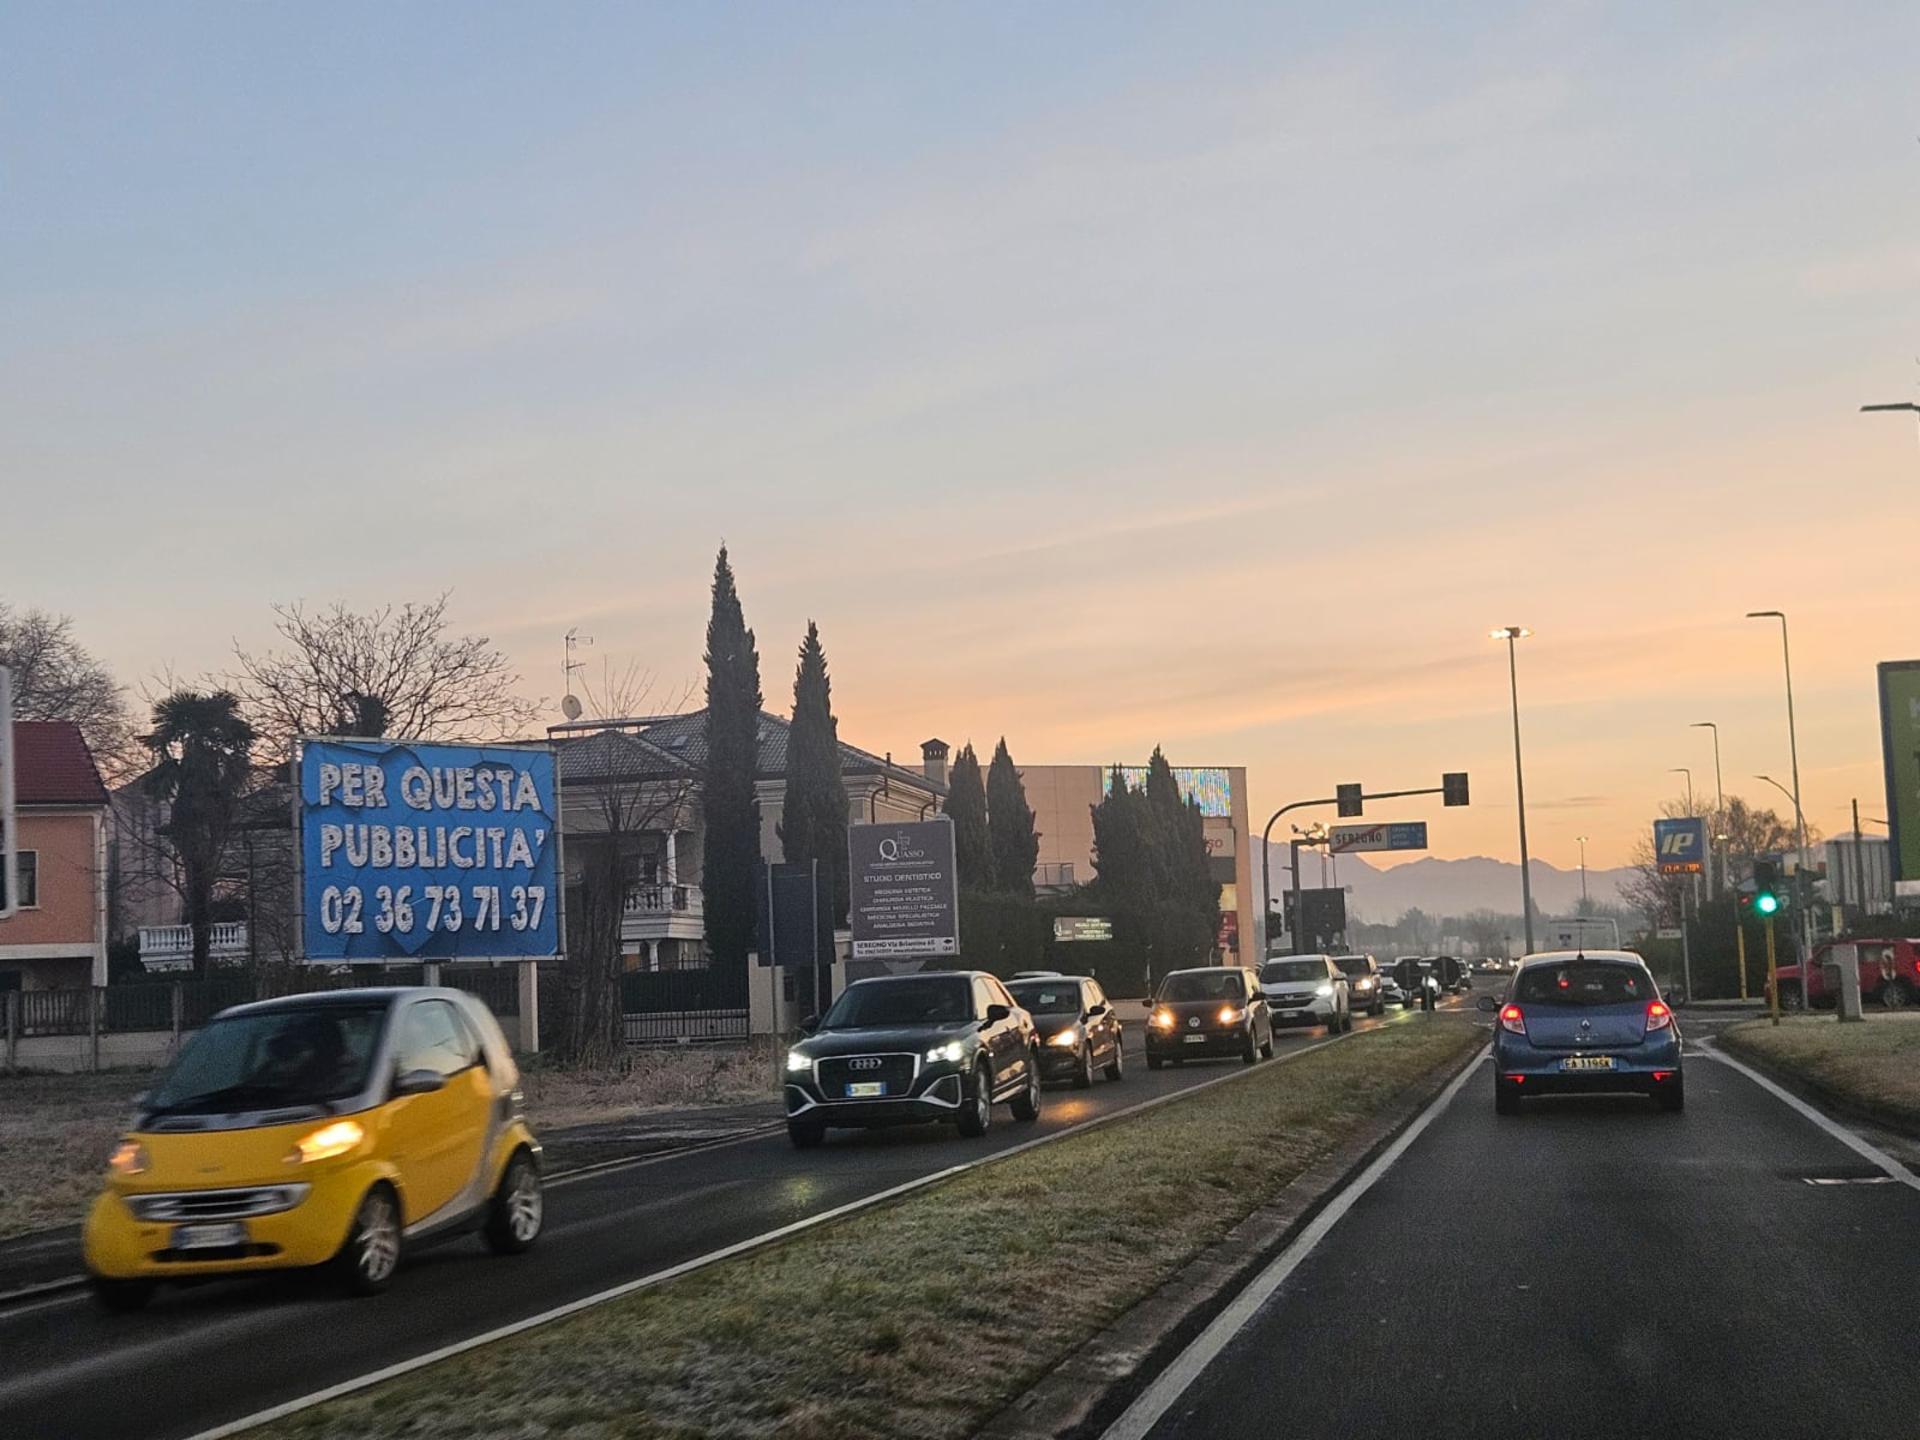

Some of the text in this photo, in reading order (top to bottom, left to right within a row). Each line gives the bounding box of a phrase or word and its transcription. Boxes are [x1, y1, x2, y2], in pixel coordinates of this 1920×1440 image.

[319, 763, 542, 811] PER QUESTA
[320, 824, 545, 869] PUBBLICITA'
[1661, 832, 1694, 856] IP
[863, 872, 942, 883] STUDIO DENTISTICO
[320, 885, 546, 934] 02 36 73 71 37
